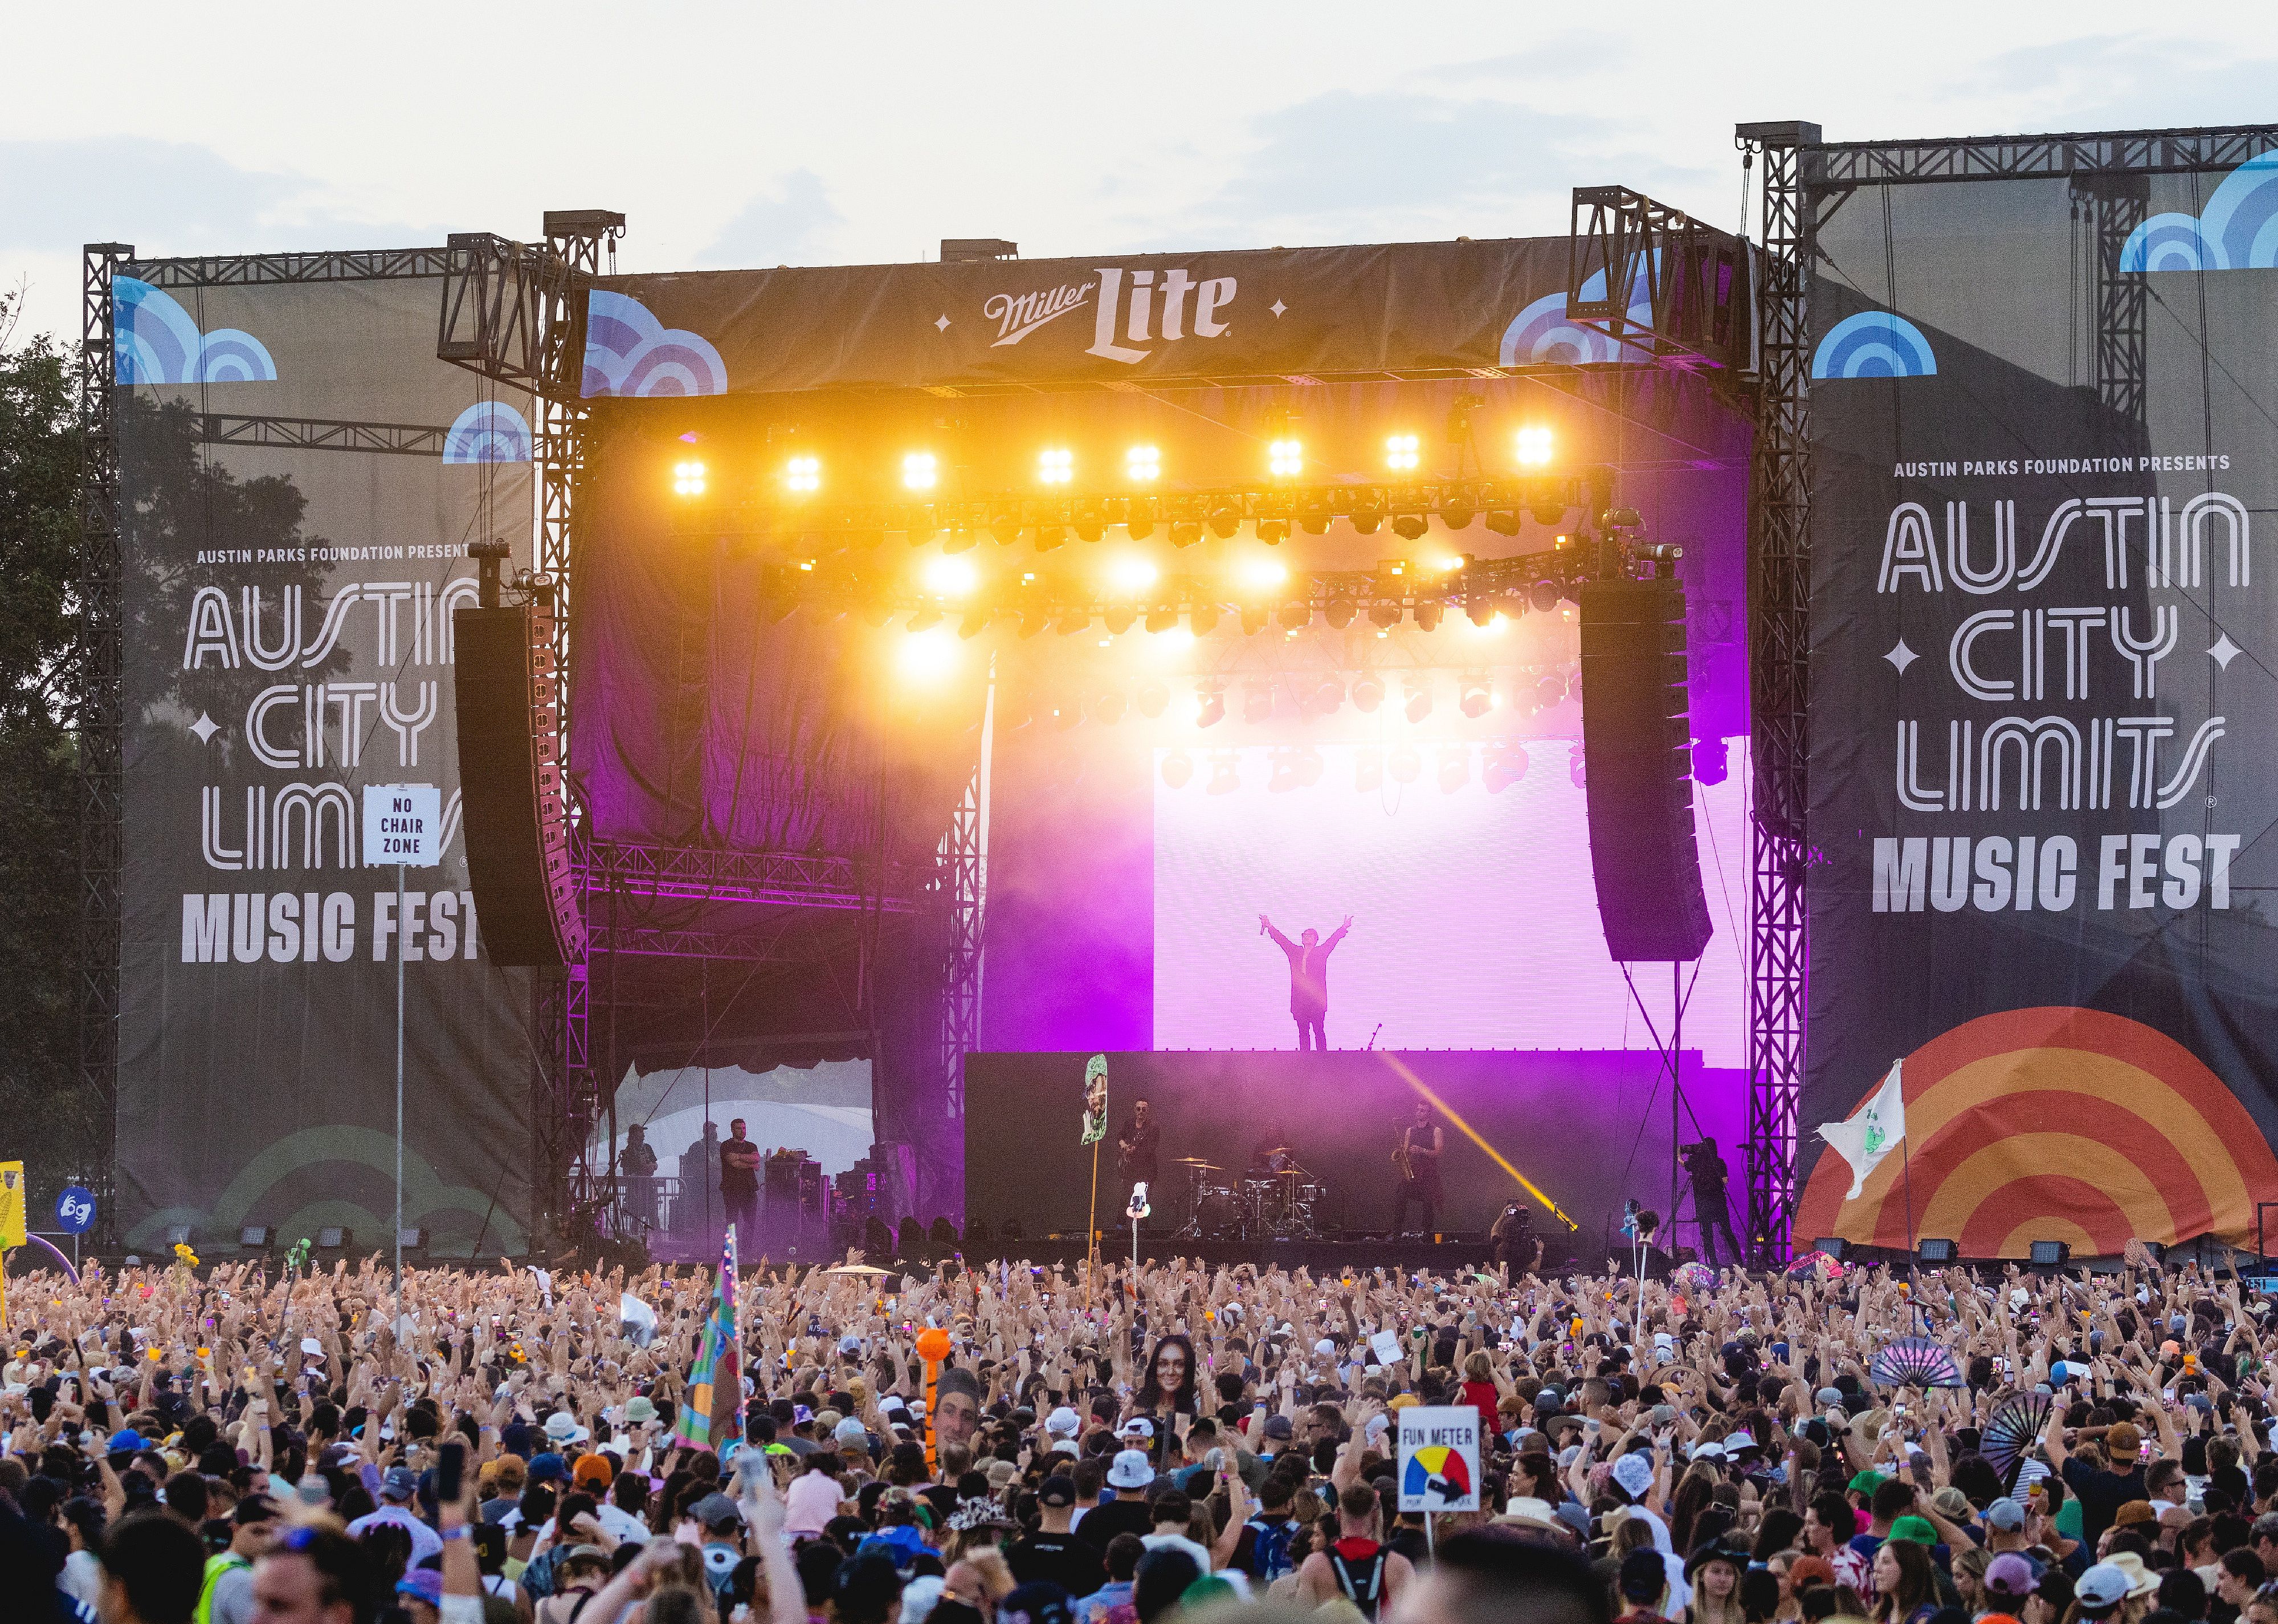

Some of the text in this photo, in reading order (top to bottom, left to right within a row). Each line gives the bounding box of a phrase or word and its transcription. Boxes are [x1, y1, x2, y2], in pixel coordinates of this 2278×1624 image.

[984, 281, 1095, 339] Miller
[1894, 454, 2231, 478] AUSTIN PARKS FOUNDATION PRESENTS
[197, 543, 470, 564] AUSTIN PARKS FOUNDATION PRESENT
[1877, 492, 2251, 594] AUSTIN
[1949, 605, 2179, 701] CITY
[246, 680, 437, 769] CITY
[381, 818, 423, 834] CHAIR
[393, 798, 411, 813] NO
[383, 838, 420, 854] ZONE
[1872, 833, 2242, 912] MUSIC FEST
[182, 892, 355, 963] MUSIC
[1403, 1427, 1473, 1446] FUN METER
